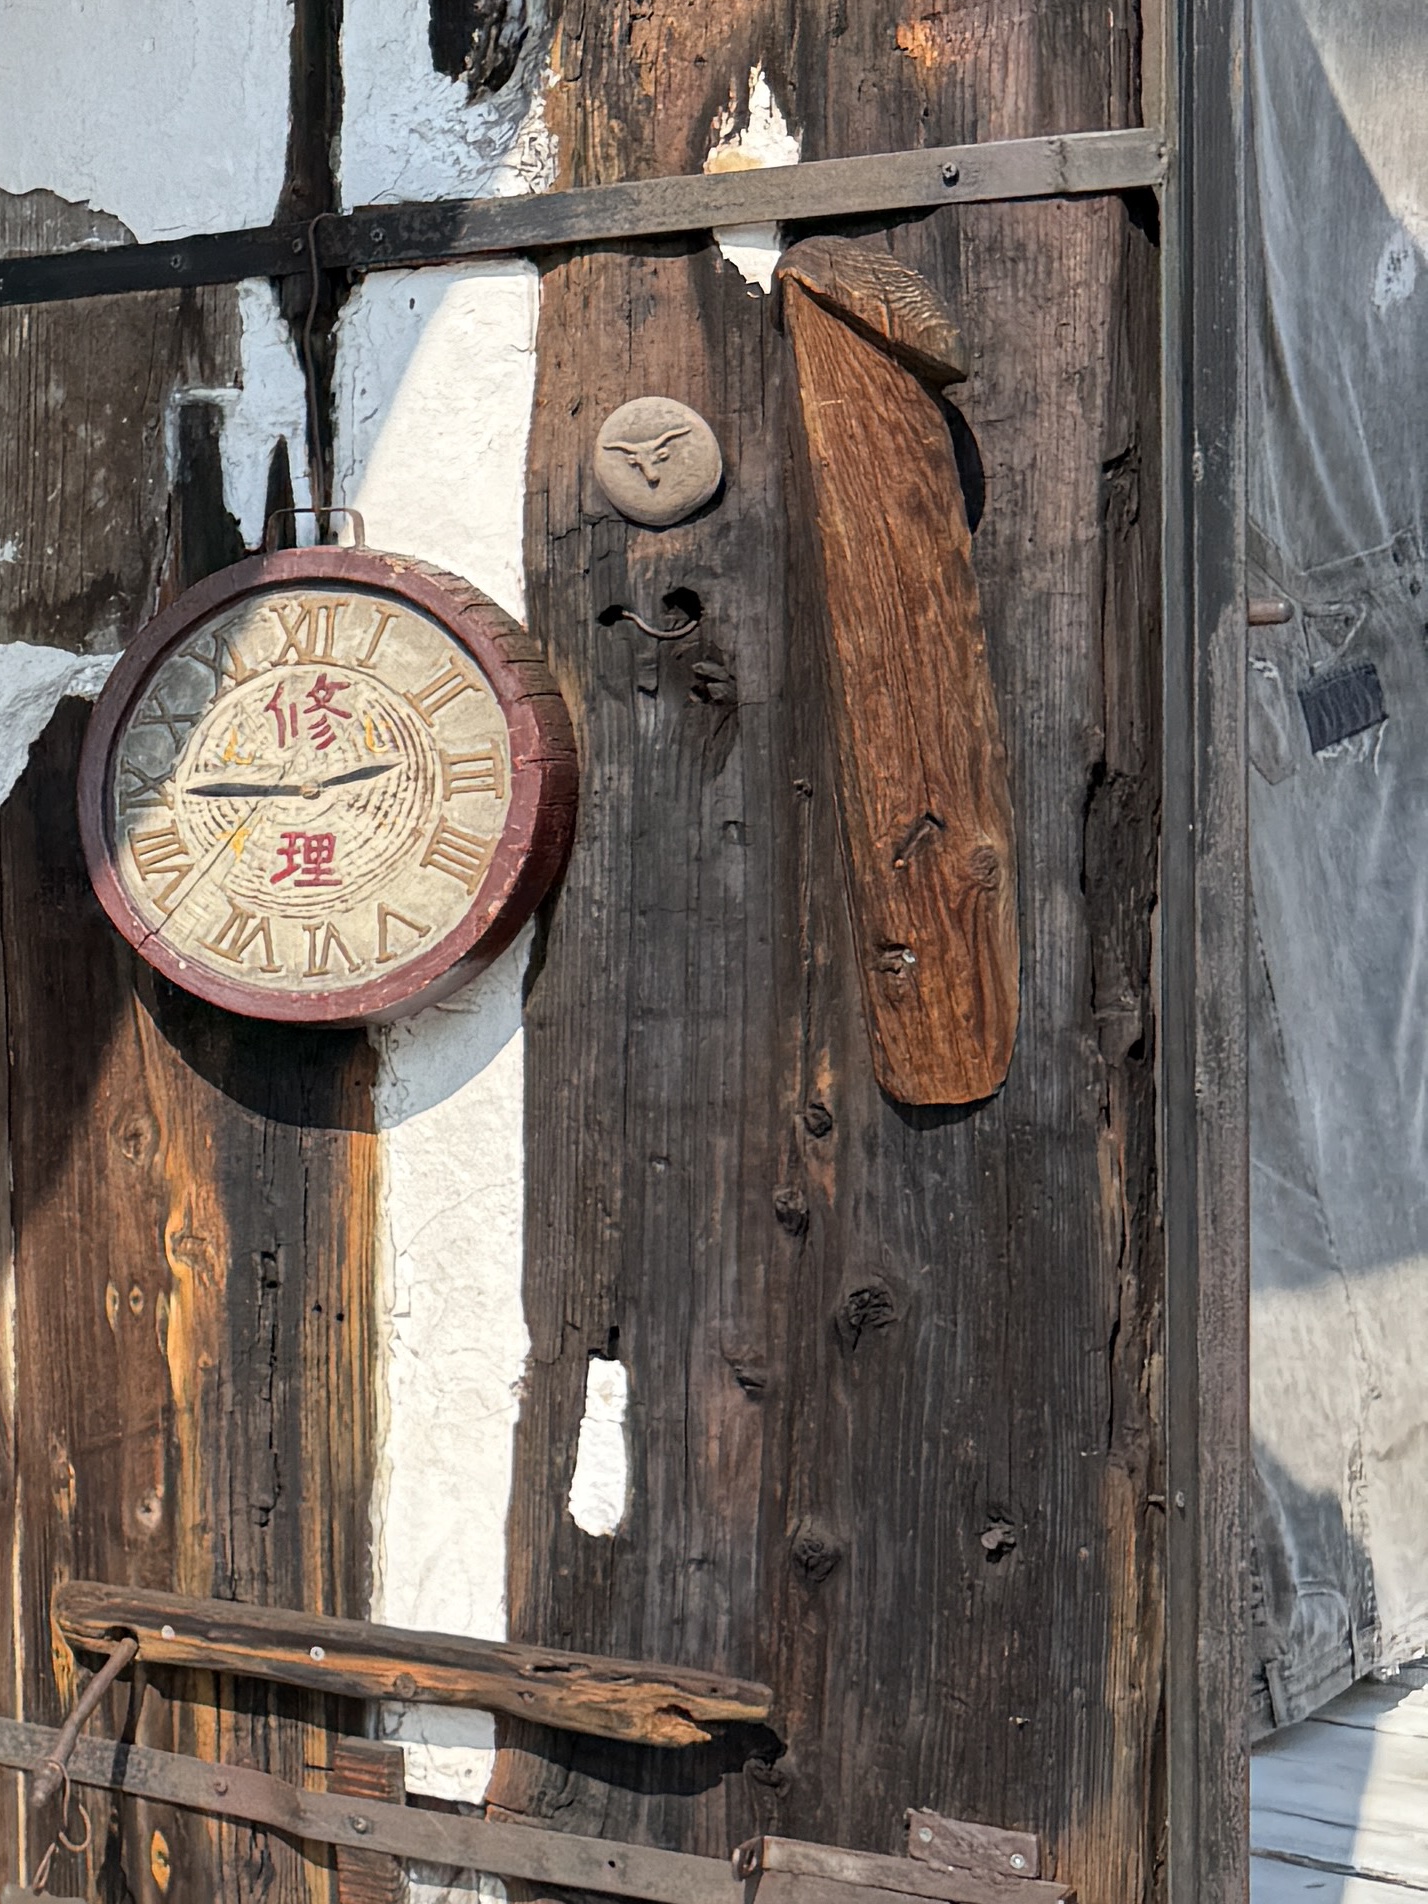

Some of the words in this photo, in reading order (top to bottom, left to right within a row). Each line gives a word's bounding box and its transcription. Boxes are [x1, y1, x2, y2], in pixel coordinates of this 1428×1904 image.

[178, 617, 259, 704] XI
[269, 596, 350, 667] XII
[356, 602, 400, 669] I
[131, 683, 202, 754] X
[402, 655, 484, 729] II
[264, 673, 352, 886] 修理
[442, 739, 506, 802] III
[194, 897, 285, 973] VII
[301, 921, 363, 978] VI
[375, 902, 432, 963] V
